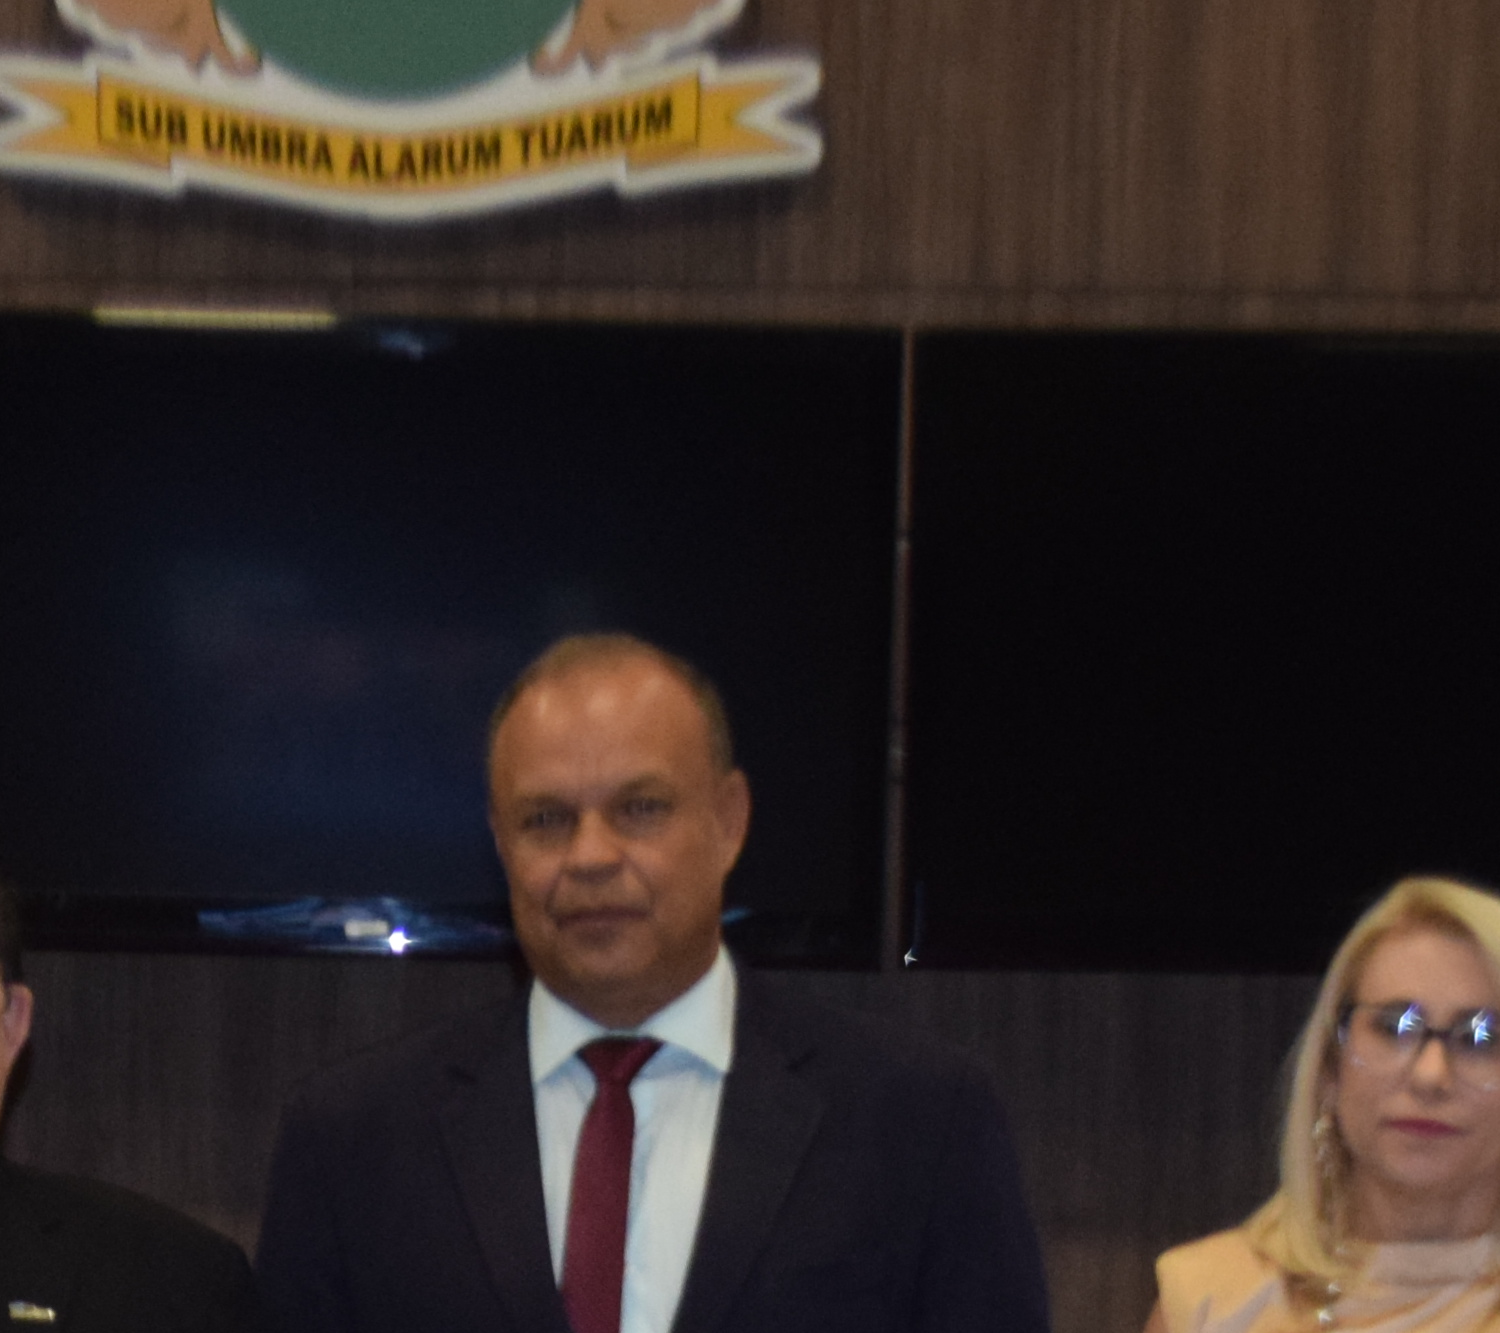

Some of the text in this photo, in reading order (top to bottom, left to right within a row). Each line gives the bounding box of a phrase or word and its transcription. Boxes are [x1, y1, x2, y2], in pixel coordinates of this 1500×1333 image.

[202, 111, 334, 174] UMBRA
[346, 129, 502, 184] ALARUM
[517, 96, 674, 164] TUARUM
